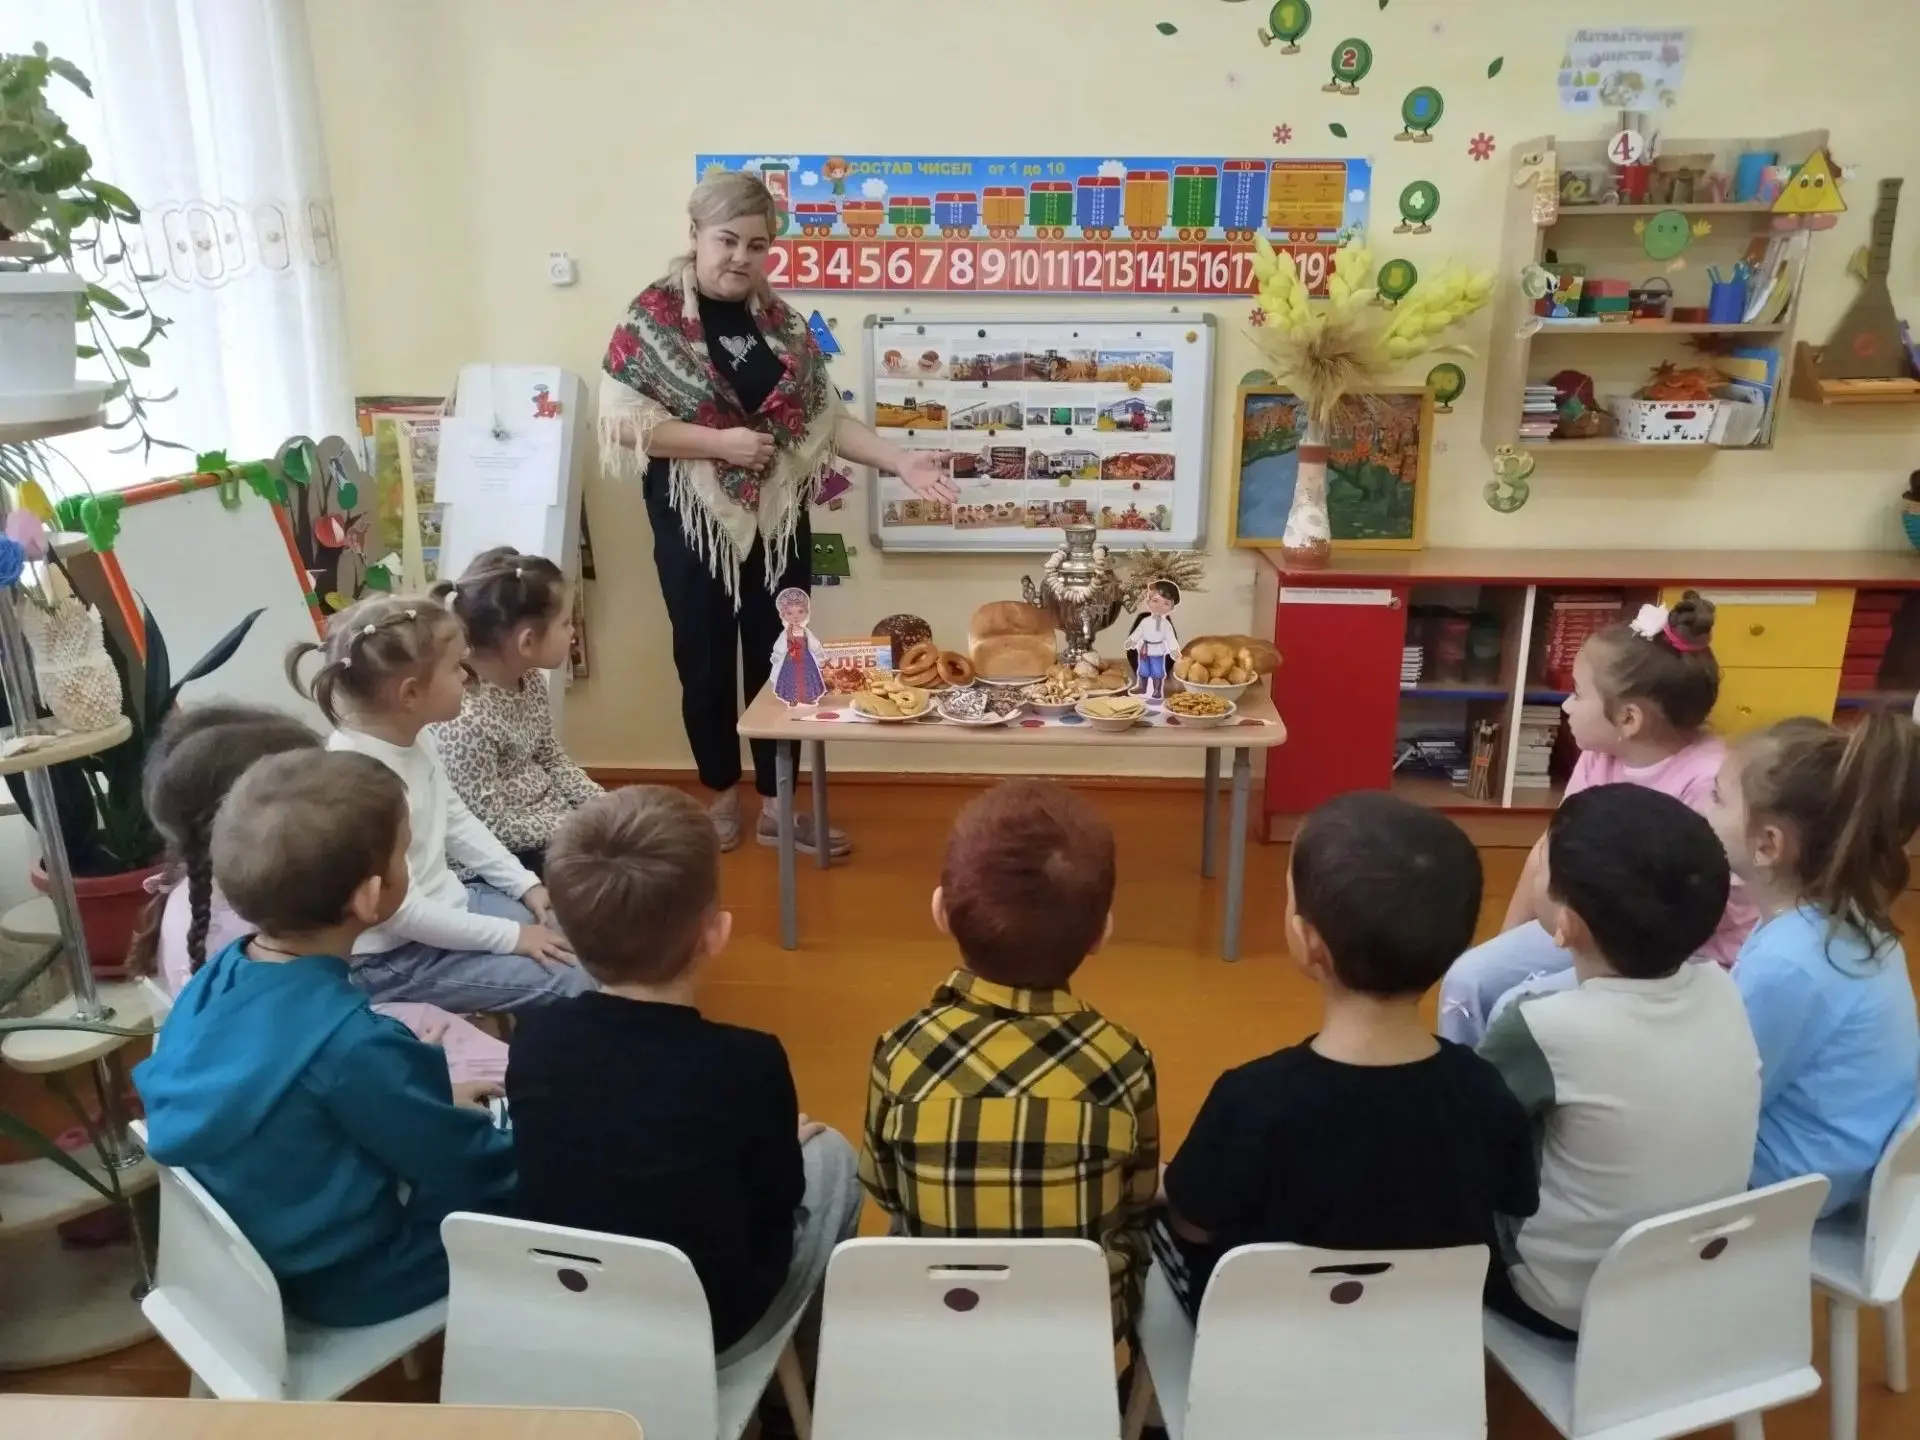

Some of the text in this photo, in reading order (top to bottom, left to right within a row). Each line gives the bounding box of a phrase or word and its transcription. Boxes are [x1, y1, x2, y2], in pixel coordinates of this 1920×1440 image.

[1341, 48, 1357, 68] 2
[1612, 132, 1635, 161] 4
[849, 161, 1066, 177] СОСТАВ ЧИСЕЛ от 1 до 10
[1409, 190, 1425, 210] 4
[767, 246, 1326, 290] 2 3 4 5 6 7 8 9 10 11 12 13 14 15 16 17 19
